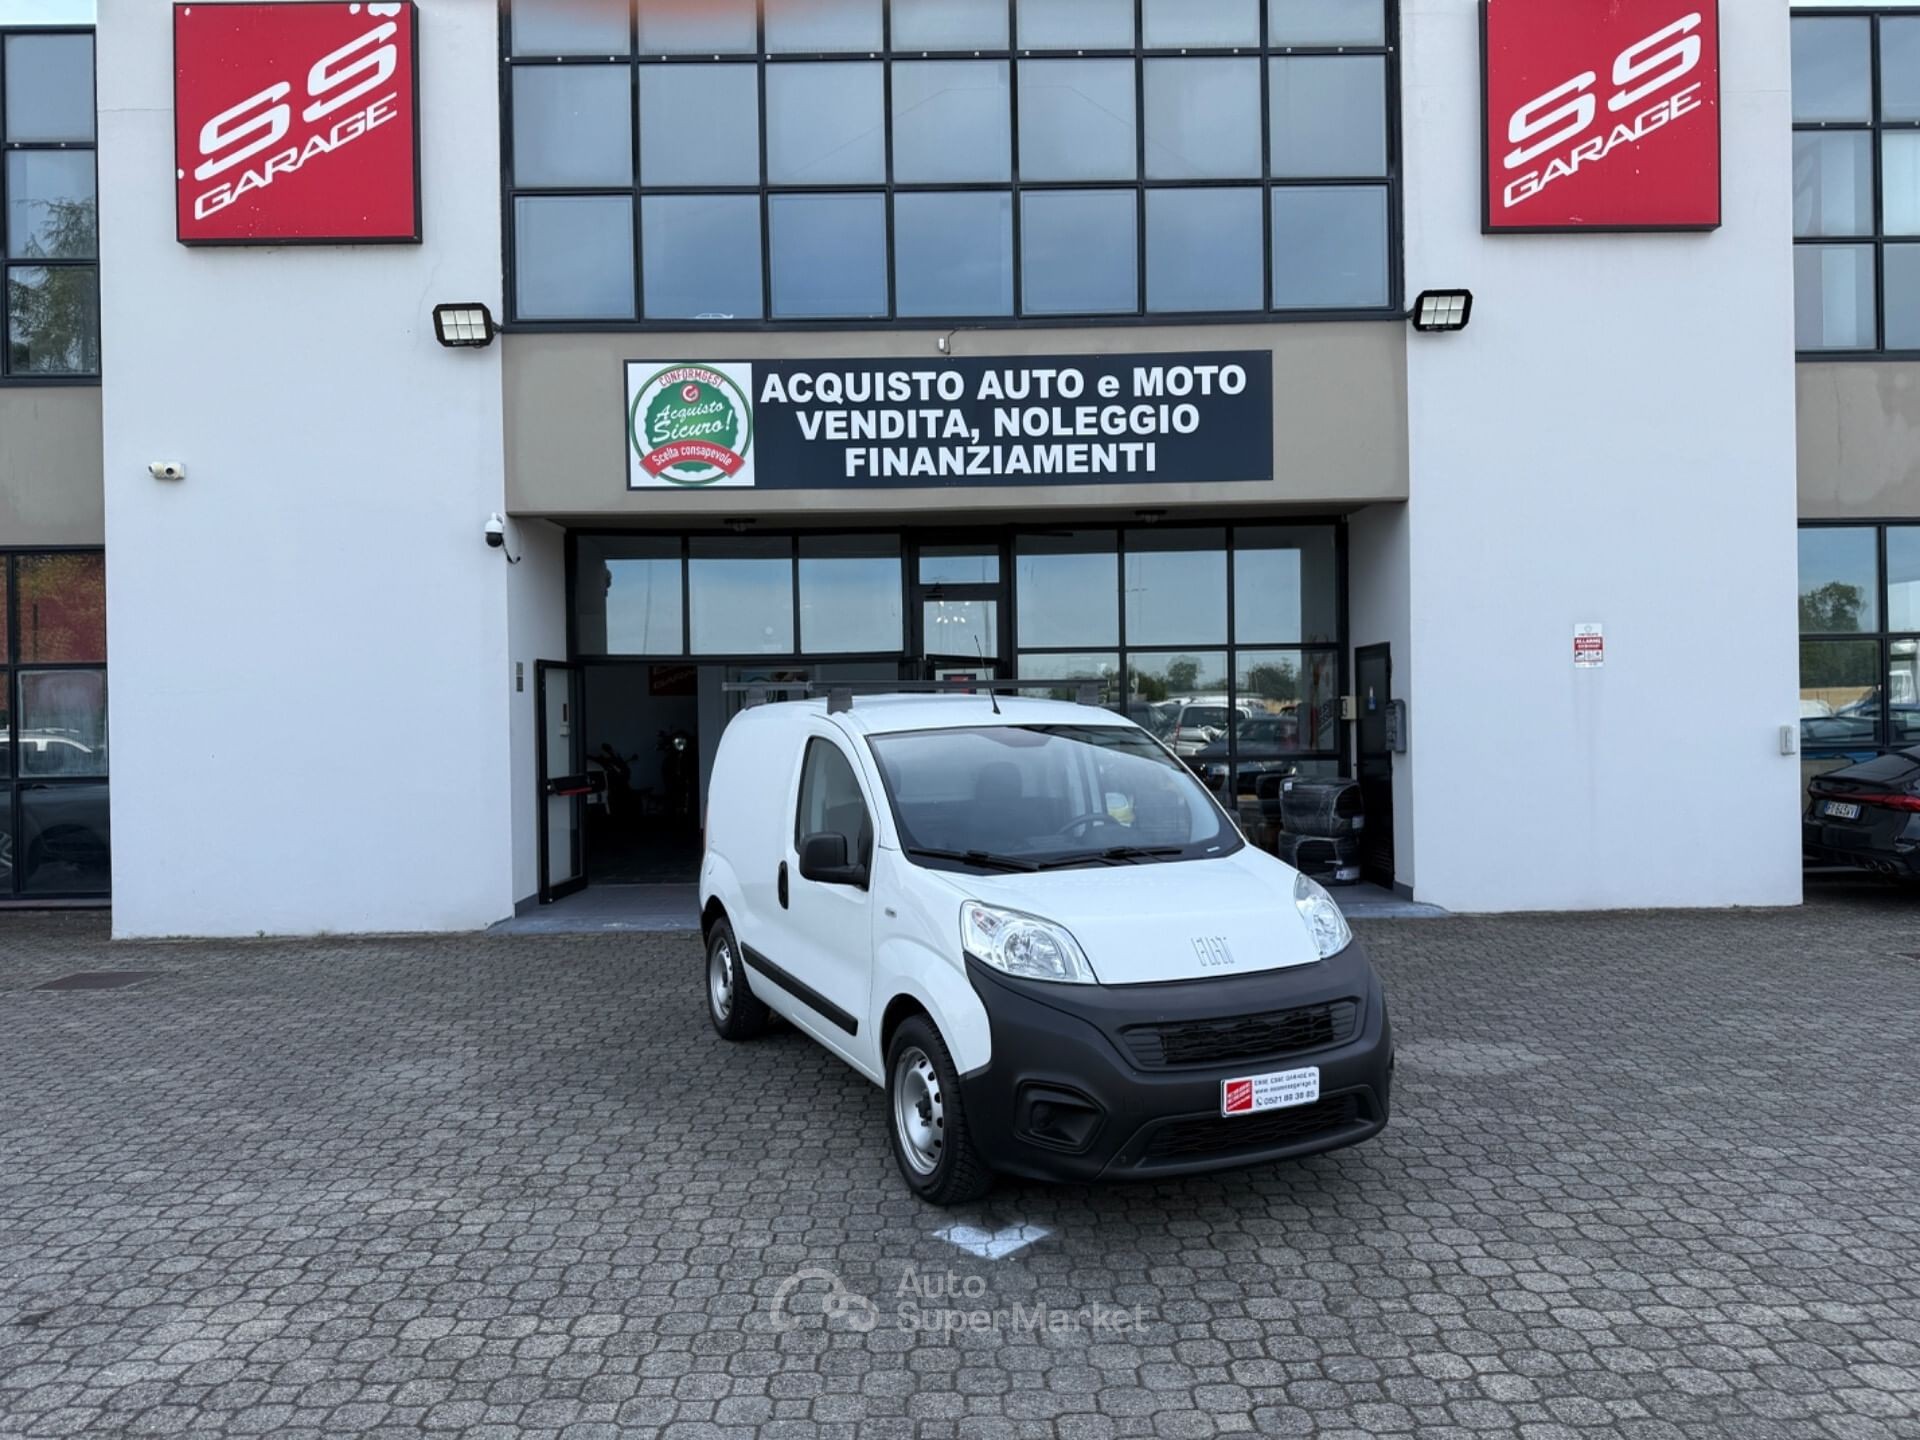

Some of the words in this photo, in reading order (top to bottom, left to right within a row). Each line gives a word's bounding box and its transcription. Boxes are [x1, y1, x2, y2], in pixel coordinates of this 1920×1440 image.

[194, 92, 397, 220] GARAGE
[1503, 82, 1702, 208] GARAGE
[760, 371, 965, 404] ACQUISTO
[976, 368, 1085, 400] AUTO
[1097, 373, 1120, 398] e
[1133, 364, 1247, 397] MOTO
[652, 409, 733, 442] Sicuro!
[654, 400, 725, 423] Acquisto
[796, 408, 980, 444] VENDITA,
[994, 404, 1201, 438] NOLEGGIO
[651, 447, 680, 465] Scelta
[681, 445, 732, 465] consapevole
[845, 442, 1157, 477] FINANZIAMENTI
